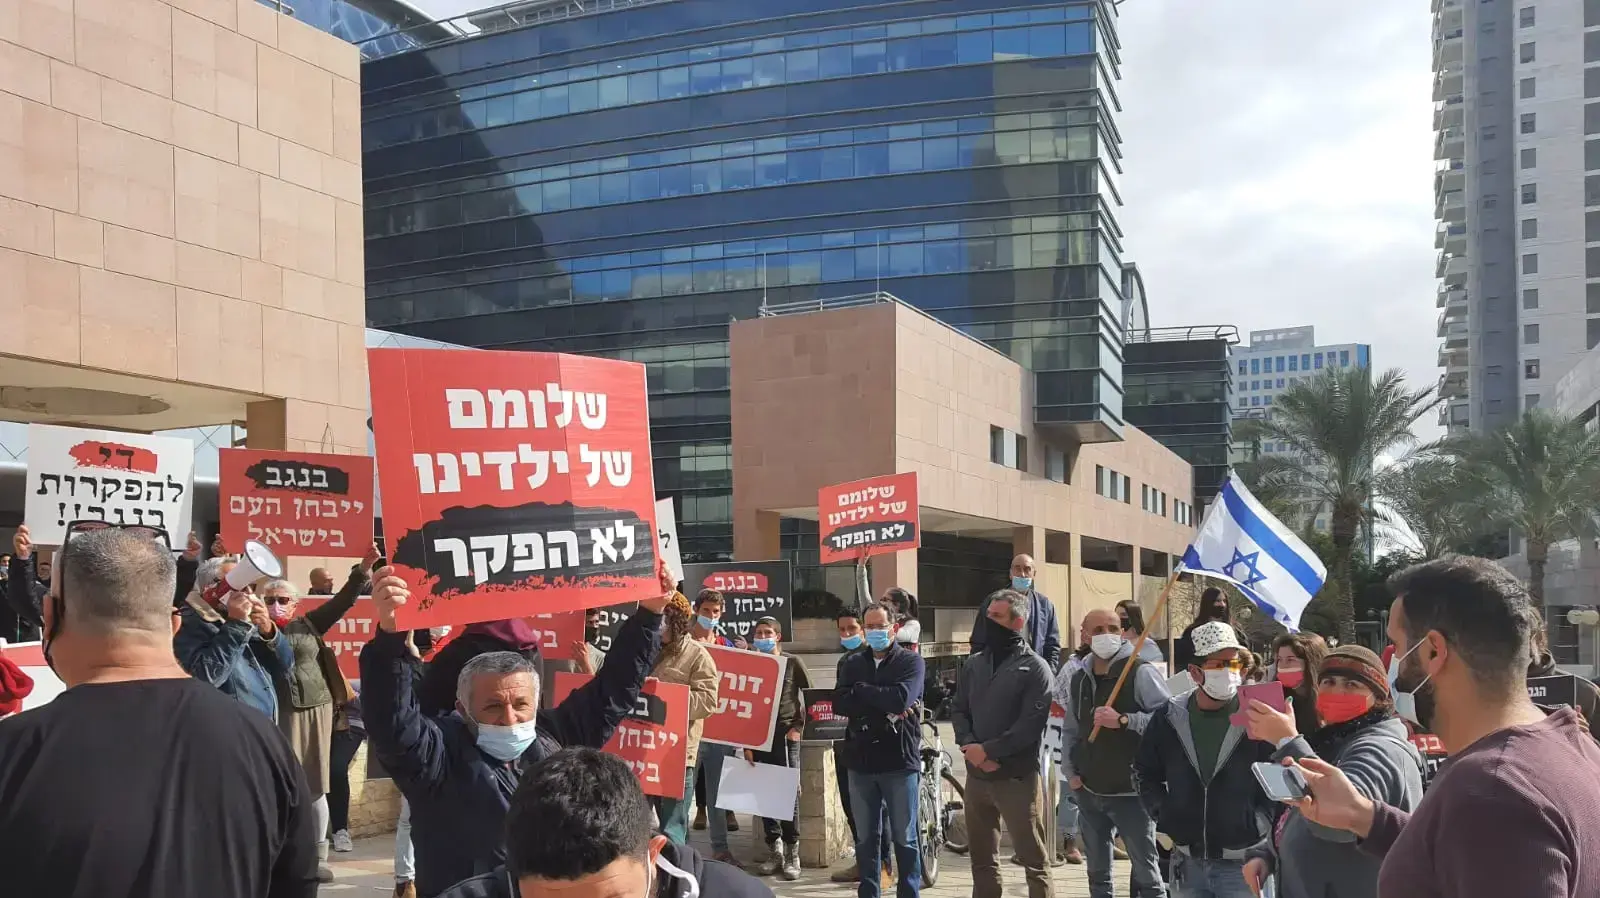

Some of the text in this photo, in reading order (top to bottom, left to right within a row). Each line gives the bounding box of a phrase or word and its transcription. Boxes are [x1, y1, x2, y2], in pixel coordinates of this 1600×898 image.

[445, 382, 607, 430] שלומם
[99, 446, 134, 470] די
[413, 442, 632, 494] של ילדינו
[36, 472, 184, 503] להפקרות
[265, 466, 329, 488] בנגב
[229, 495, 365, 520] ייבחן העם
[837, 484, 896, 507] שלומם
[828, 500, 908, 526] של ילדינו
[247, 520, 346, 548] בישראל
[590, 519, 635, 564] לא
[831, 522, 906, 550] לא הפקר
[434, 529, 579, 586] הפקר
[714, 575, 759, 591] בנגב
[733, 596, 784, 615] ייבחן
[336, 618, 373, 634] דור
[717, 671, 763, 695] דור
[618, 725, 679, 750] ייבחן
